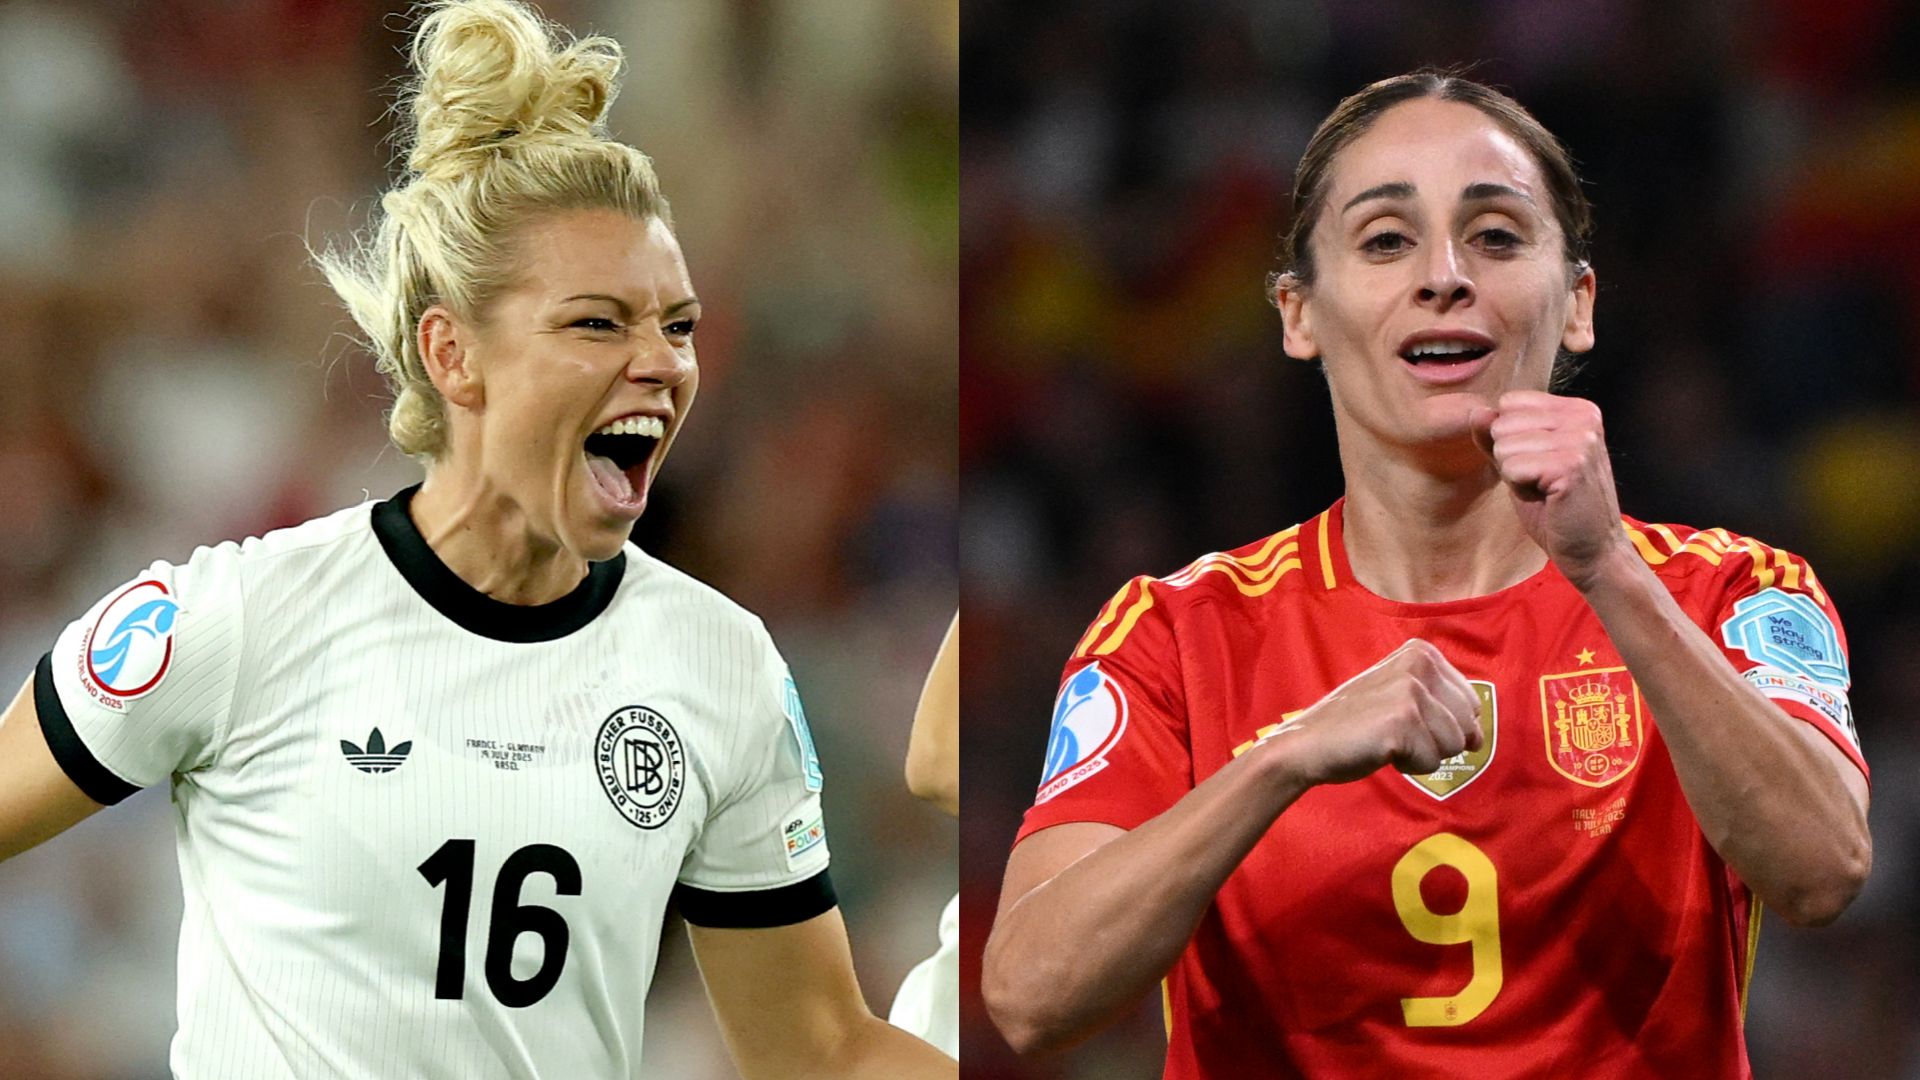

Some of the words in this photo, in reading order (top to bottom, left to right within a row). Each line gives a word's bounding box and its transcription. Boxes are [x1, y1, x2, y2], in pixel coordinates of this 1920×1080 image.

[1768, 615, 1793, 628] We
[99, 693, 123, 710] 2025
[1756, 677, 1843, 714] UNDATION
[466, 738, 497, 750] FRANCE
[507, 742, 545, 754] GERMANY
[491, 750, 509, 760] JULY
[511, 752, 533, 762] 2025
[600, 716, 626, 806] DEUTSCHER
[494, 760, 520, 771] BASEL
[1071, 759, 1102, 780] 2025
[1438, 764, 1476, 772] HAMPIONS
[1428, 770, 1454, 781] 2023
[635, 808, 652, 823] 125
[1572, 808, 1596, 820] ITALY
[787, 825, 820, 853] FOUN
[416, 838, 583, 1009] 16
[1391, 831, 1504, 1028] 9
